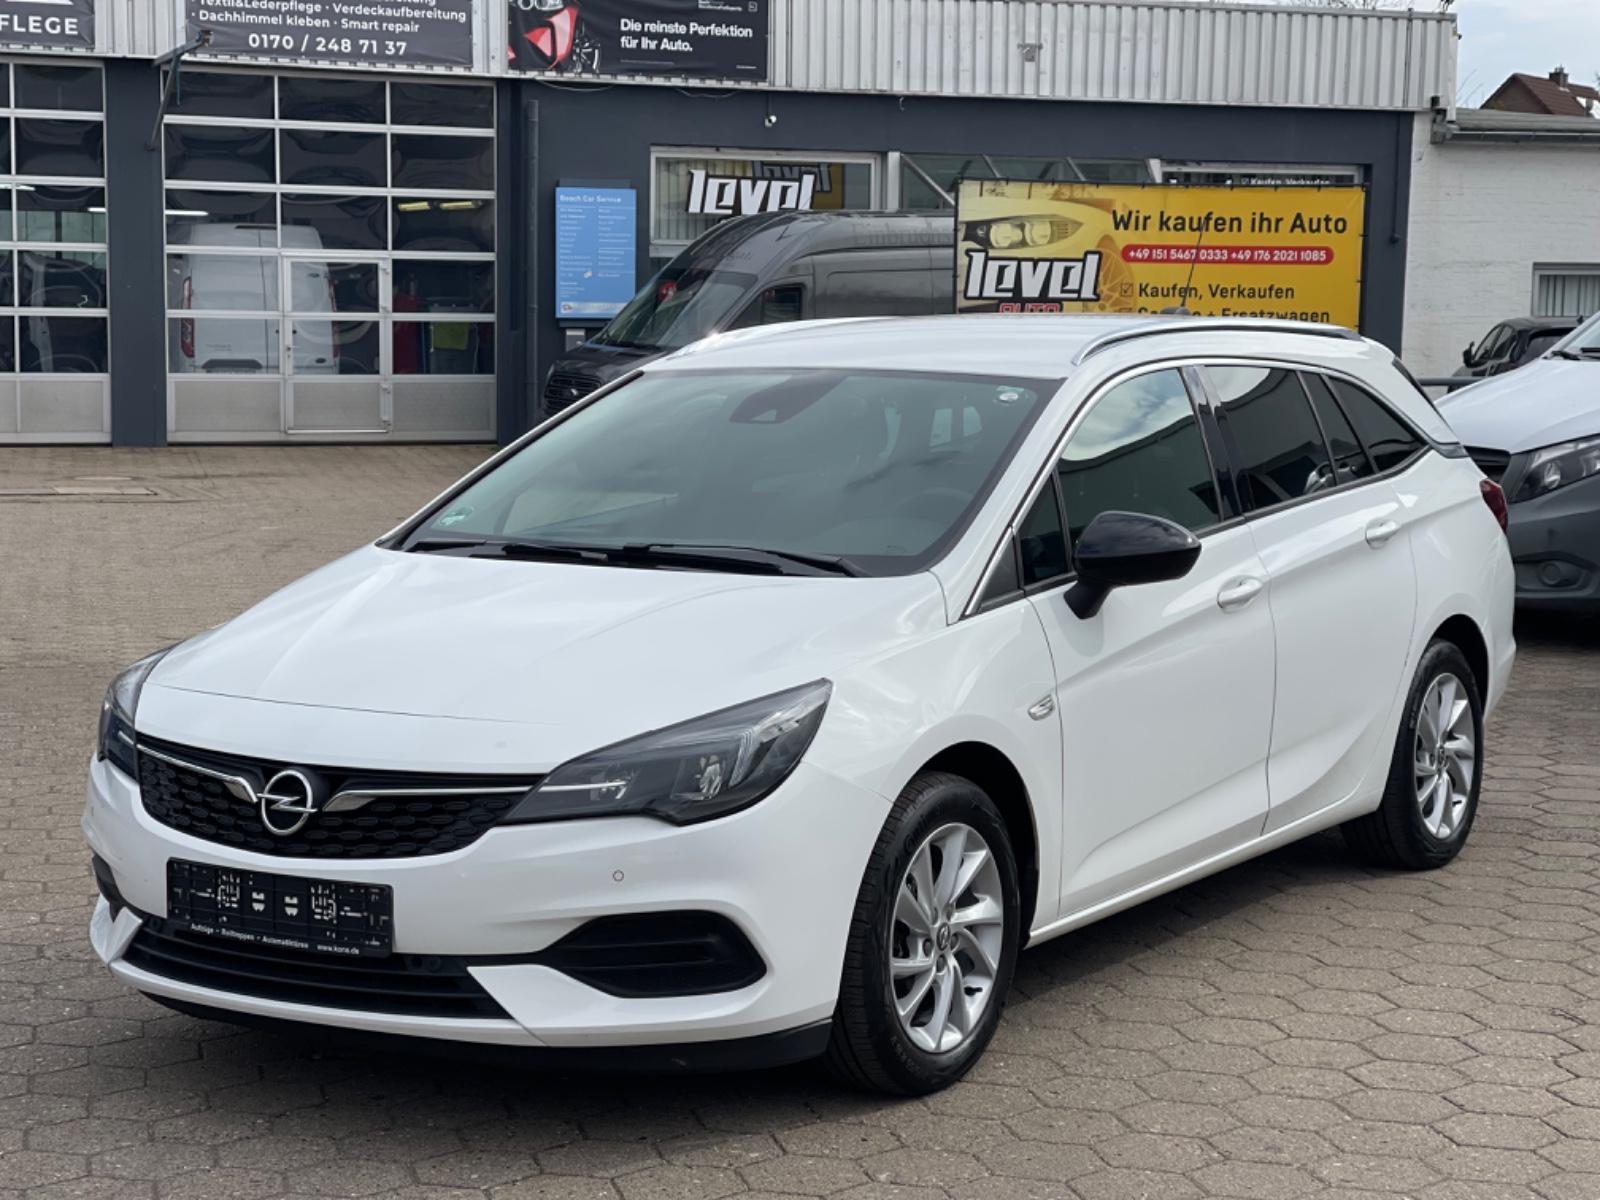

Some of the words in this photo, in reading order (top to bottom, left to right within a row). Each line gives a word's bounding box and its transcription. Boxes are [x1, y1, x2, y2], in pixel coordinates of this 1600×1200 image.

[200, 10, 282, 25] Dachhimmel
[286, 15, 330, 28] kleben
[341, 18, 379, 31] Smart
[382, 21, 420, 34] repair
[333, 3, 466, 23] Verdeckaufbereitung
[620, 18, 642, 31] Die
[644, 20, 687, 34] reinste
[689, 22, 753, 38] Perfektion
[248, 33, 294, 49] 0170
[315, 37, 351, 53] 248
[359, 39, 378, 54] 71
[385, 40, 407, 55] 37
[620, 36, 639, 49] für
[641, 36, 658, 50] Ihr
[660, 38, 693, 52] Auto.
[1112, 210, 1151, 231] Wir
[1158, 211, 1243, 233] kaufen
[1251, 212, 1283, 233] ihr
[1289, 212, 1348, 234] Auto
[1129, 248, 1150, 260] +49
[1152, 248, 1167, 260] 151
[1169, 249, 1197, 260] 5467
[1200, 249, 1228, 260] 0333
[1231, 249, 1251, 261] +49
[1254, 249, 1271, 261] 176
[1273, 250, 1297, 261] 2021
[1301, 250, 1327, 262] 1085
[1138, 282, 1202, 300] Kaufen,
[1208, 283, 1295, 299] Verkaufen
